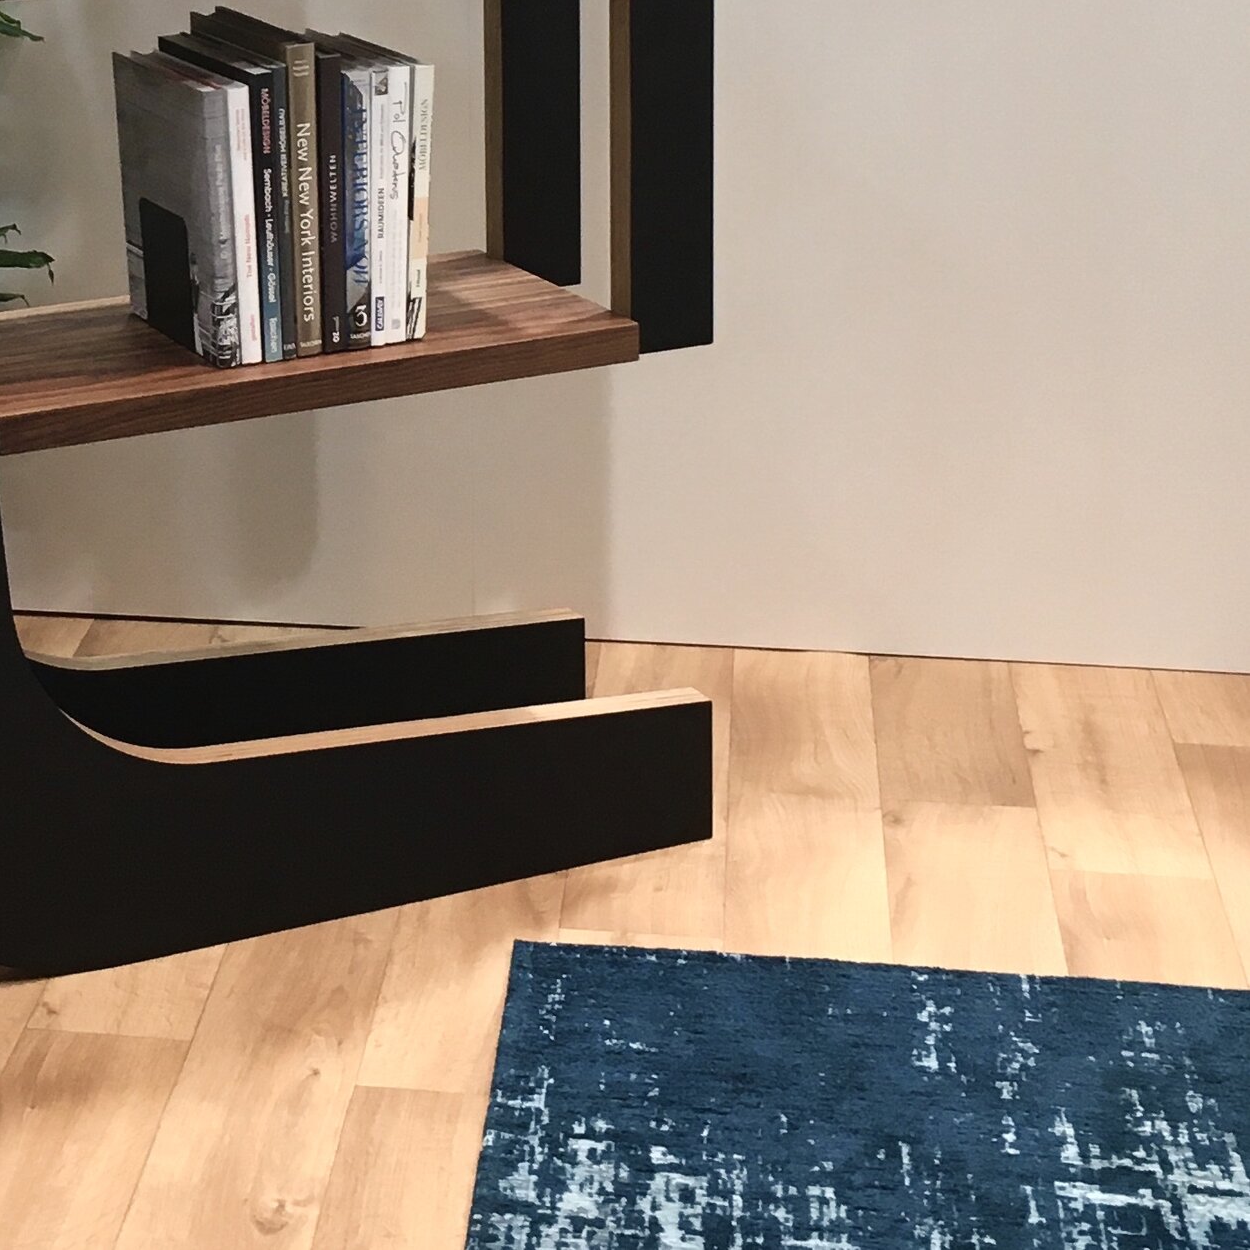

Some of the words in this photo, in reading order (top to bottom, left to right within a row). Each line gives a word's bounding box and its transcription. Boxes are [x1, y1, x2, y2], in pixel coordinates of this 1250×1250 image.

[296, 122, 311, 161] New
[262, 168, 273, 212] Sembach
[298, 165, 314, 205] New
[328, 154, 339, 244] WOHNWELTEN
[300, 208, 317, 247] York
[376, 187, 386, 239] RAUMIDEEN
[301, 251, 317, 323] Interiors
[355, 304, 368, 327] 3
